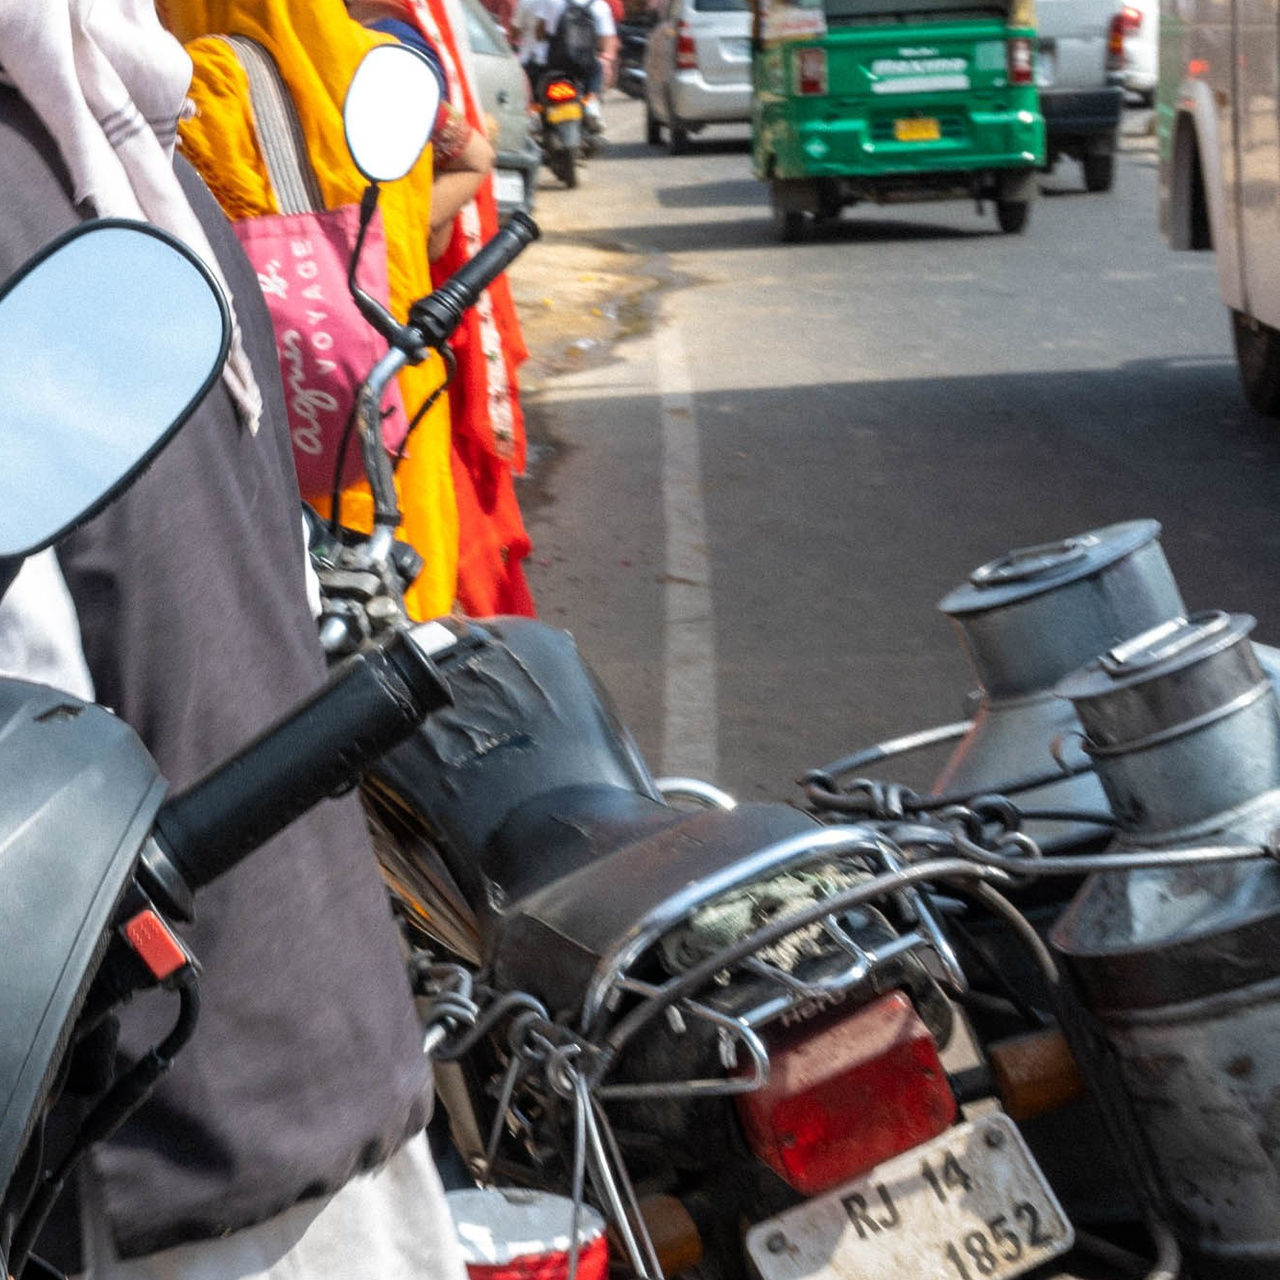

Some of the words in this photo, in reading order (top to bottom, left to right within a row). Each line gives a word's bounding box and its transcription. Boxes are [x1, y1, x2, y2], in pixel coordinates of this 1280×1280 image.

[290, 238, 337, 376] VOYAGE
[840, 1182, 901, 1240] RJ
[920, 1149, 974, 1205] 14
